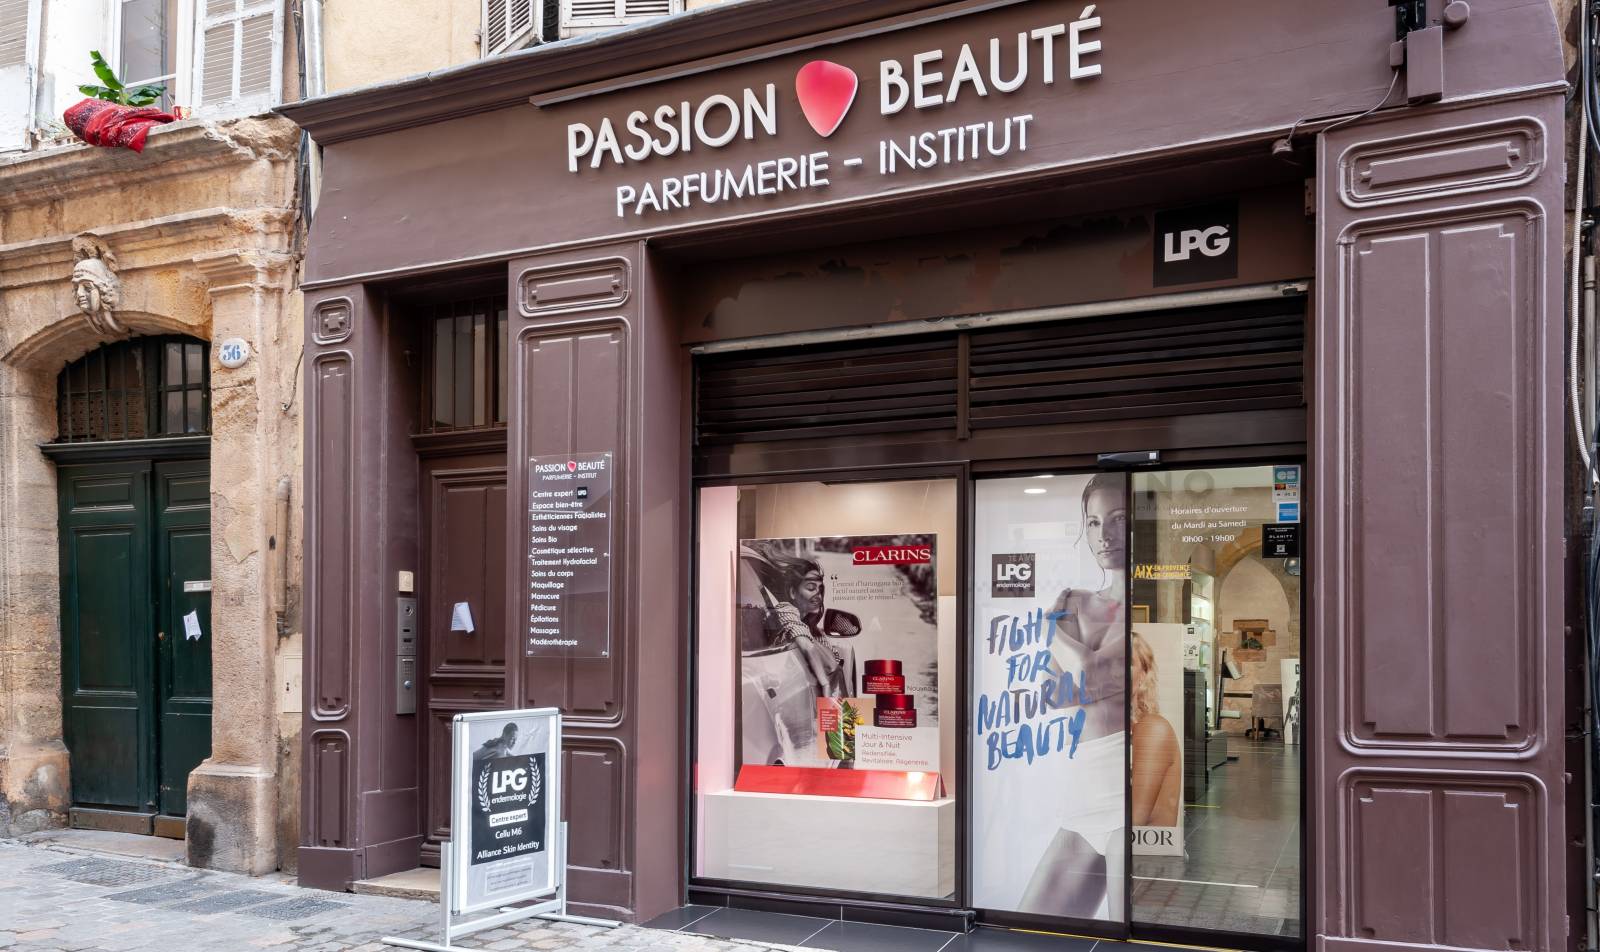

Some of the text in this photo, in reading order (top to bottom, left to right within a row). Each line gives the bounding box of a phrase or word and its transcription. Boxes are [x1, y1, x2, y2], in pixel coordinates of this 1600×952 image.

[567, 5, 1102, 173] PASSION BEAUTÉ
[616, 151, 830, 217] PARFUMERIE
[879, 114, 1034, 175] INSTITUT
[1164, 225, 1230, 262] LPG
[535, 460, 605, 473] PASSION BEAUTÉ
[532, 490, 573, 498] Centre expert
[574, 511, 606, 519] Facialistes
[1170, 505, 1248, 515] Horaires d'ouverture
[558, 524, 578, 532] visage
[1171, 521, 1182, 530] du
[1183, 521, 1206, 529] Mardi
[1218, 520, 1247, 528] Samedi
[1182, 535, 1203, 543] 10h00
[1210, 534, 1235, 542] 19h00
[531, 546, 594, 555] Cosmétique sélective
[853, 549, 931, 562] CLARINS
[996, 563, 1032, 581] LPG
[531, 581, 564, 589] Maquillage
[530, 614, 559, 623] Épilations
[530, 627, 560, 635] Massages
[987, 607, 1072, 656] FIGHT
[1006, 649, 1057, 689] FOR
[977, 670, 1093, 736] NATURAL
[886, 741, 900, 749] Nuit
[987, 708, 1087, 770] BEAUTY
[492, 767, 528, 794] LPG
[491, 792, 527, 805] endermologie
[491, 811, 527, 824] Centre expert
[495, 826, 522, 840] Cellu M6
[477, 840, 540, 860] Alliance Skin Identity
